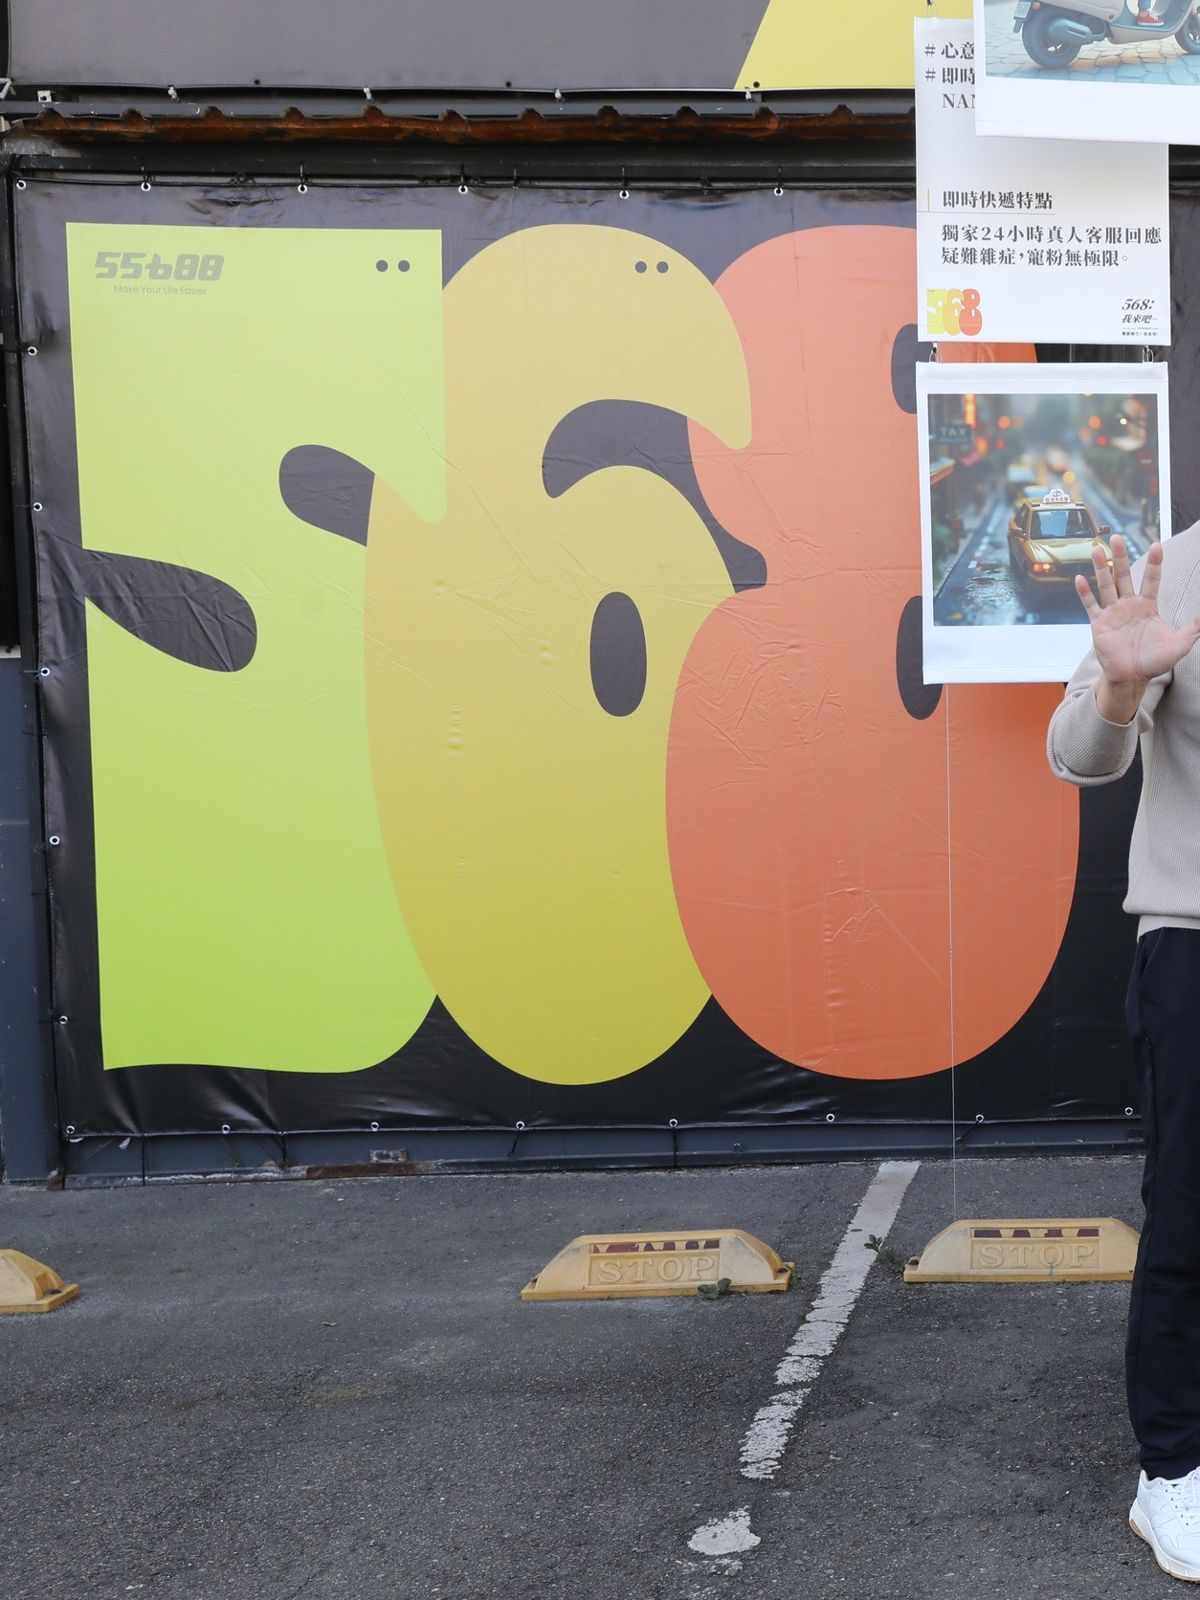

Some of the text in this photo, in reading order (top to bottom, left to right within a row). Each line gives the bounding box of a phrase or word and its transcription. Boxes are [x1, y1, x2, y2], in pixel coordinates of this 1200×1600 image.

[942, 93, 975, 109] NA
[942, 190, 1053, 210] 即時快遞特點
[941, 224, 1163, 244] 獨家24小時真人客服回應
[95, 252, 225, 281] 55688
